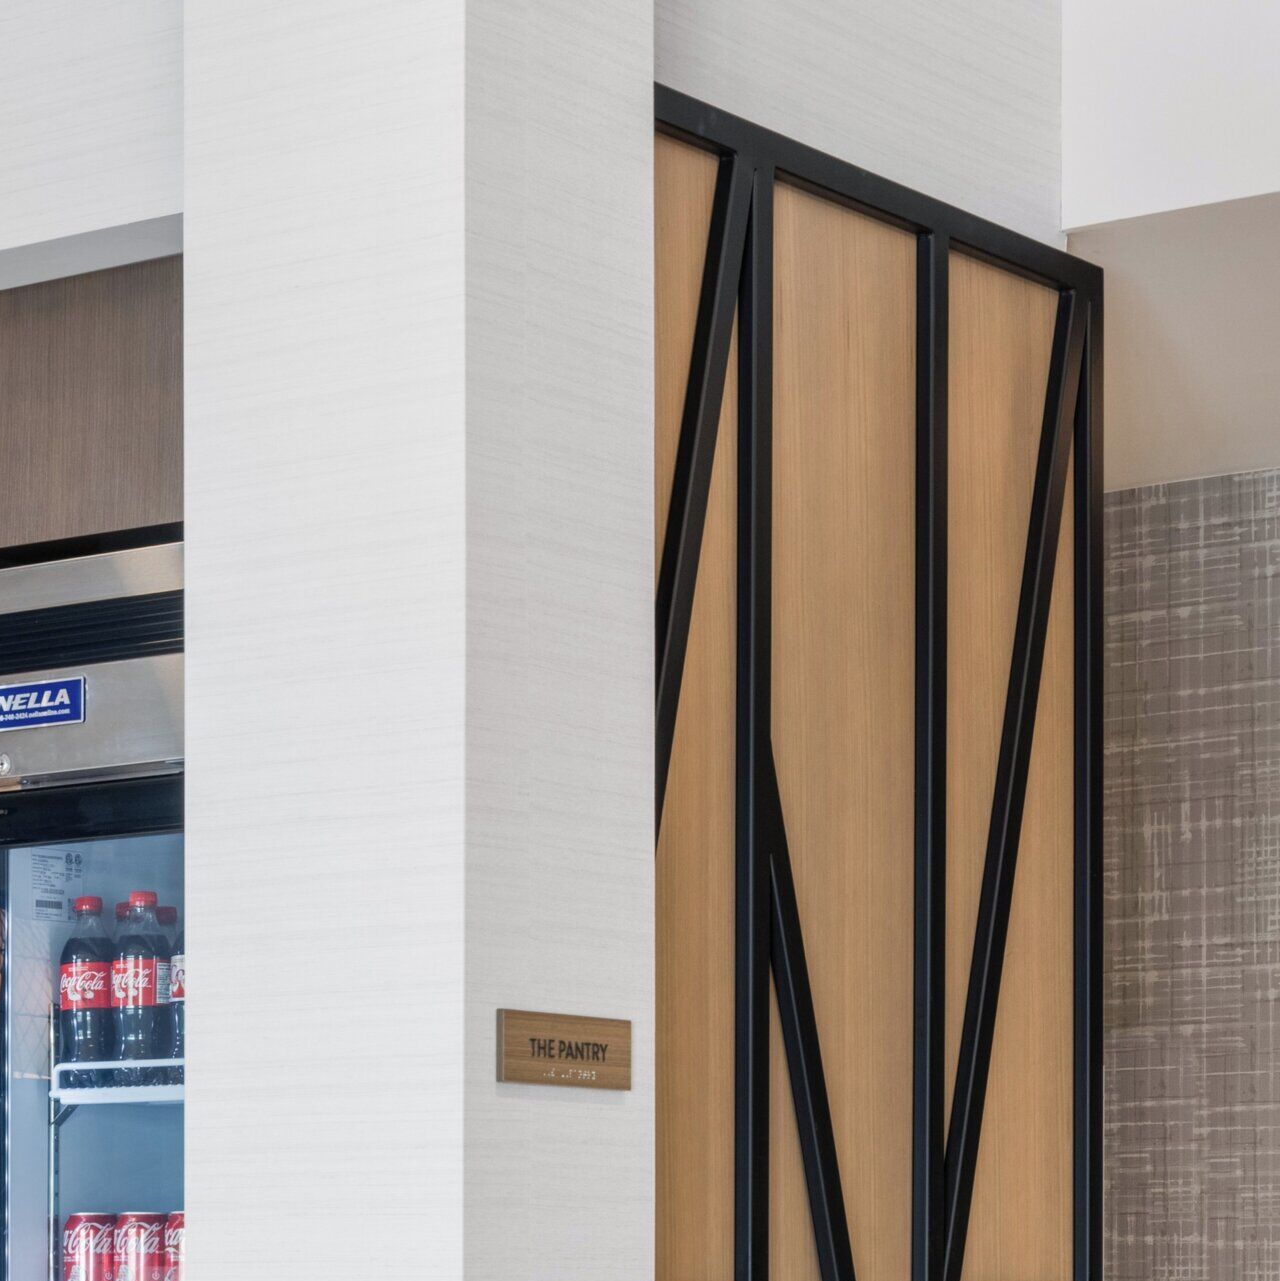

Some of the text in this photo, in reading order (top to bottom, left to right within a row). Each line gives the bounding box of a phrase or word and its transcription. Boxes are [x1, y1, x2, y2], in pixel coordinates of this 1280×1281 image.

[60, 971, 108, 993] Coca-Cola
[112, 968, 152, 989] oca-Cola
[529, 1038, 609, 1063] THE PANTRY
